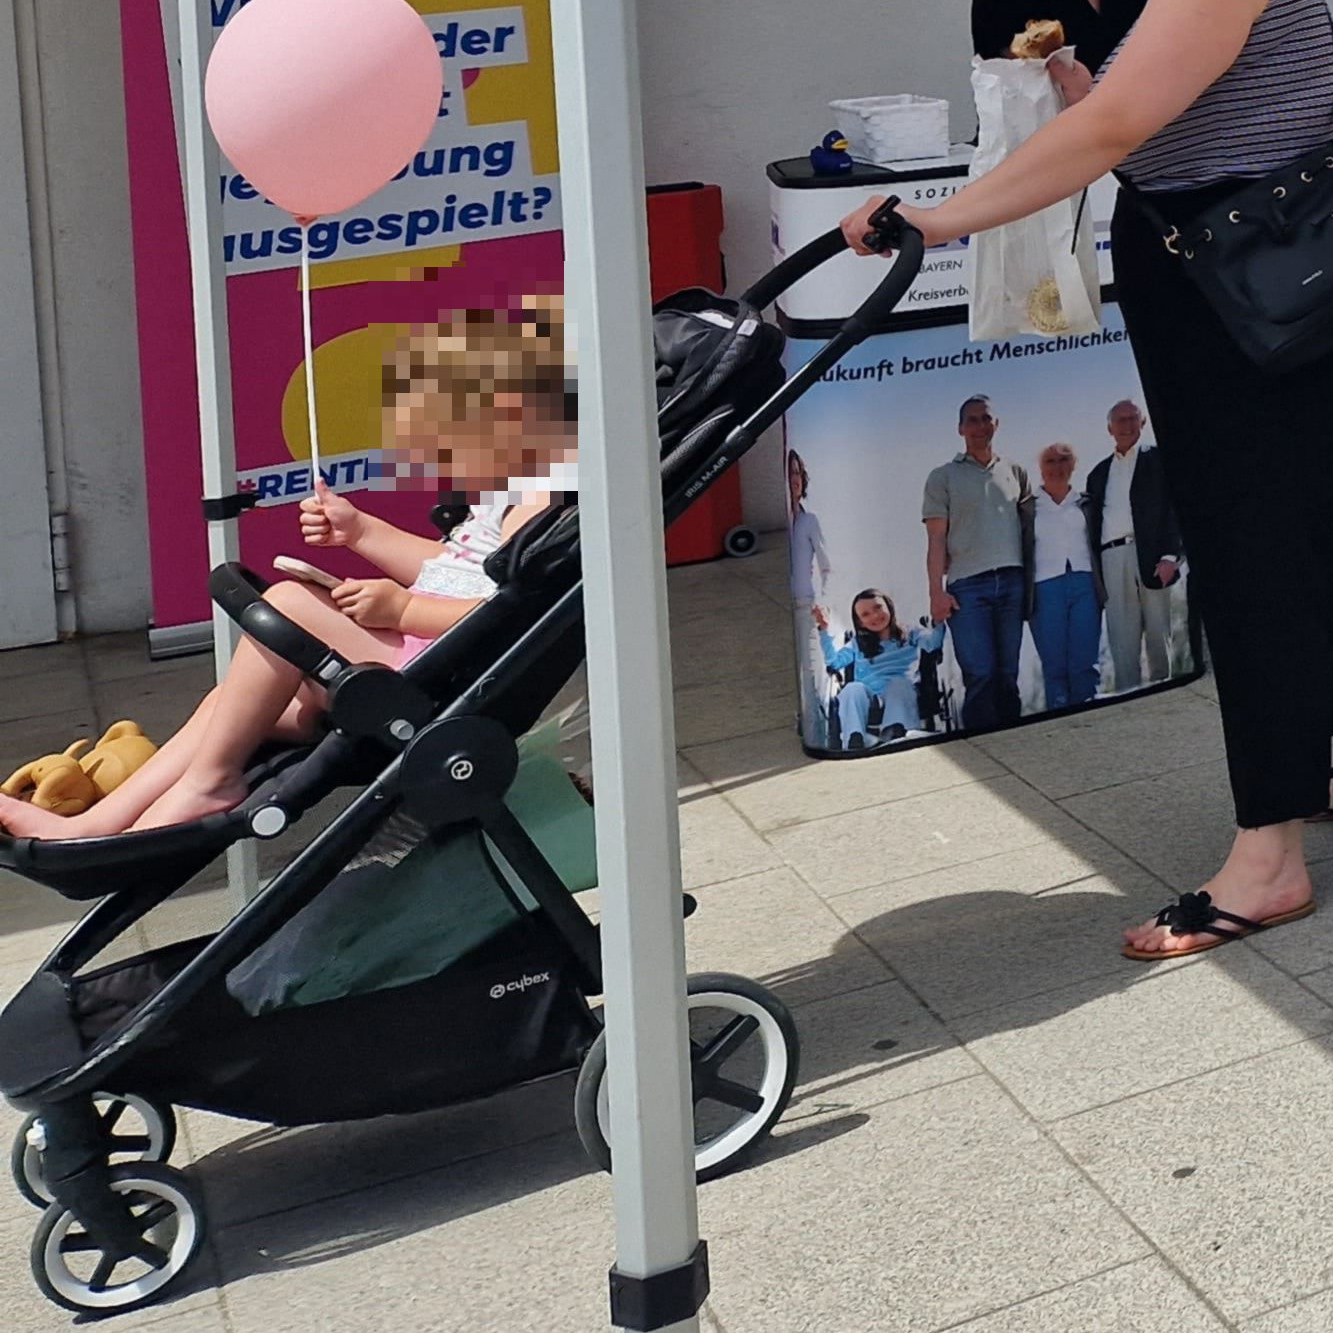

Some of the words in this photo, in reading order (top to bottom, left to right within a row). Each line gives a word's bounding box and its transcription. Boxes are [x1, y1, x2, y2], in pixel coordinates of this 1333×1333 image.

[391, 139, 516, 181] ung
[908, 283, 970, 304] Kreisverb
[813, 359, 895, 384] ukunft
[900, 348, 984, 375] braucht
[505, 971, 550, 993] cybex
